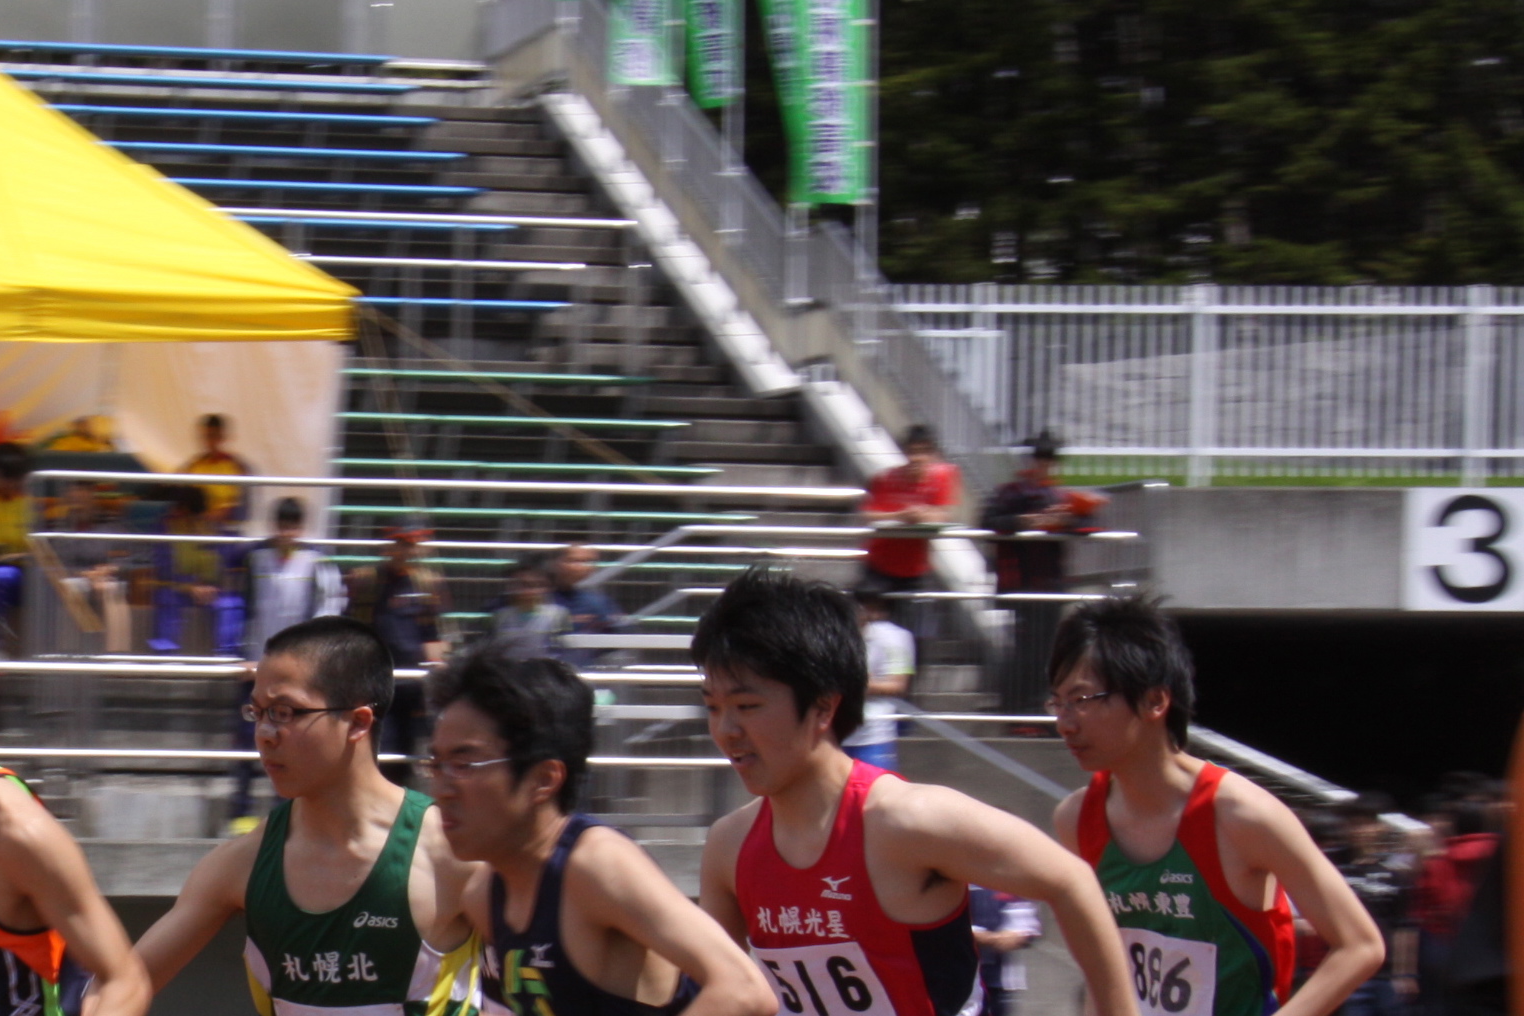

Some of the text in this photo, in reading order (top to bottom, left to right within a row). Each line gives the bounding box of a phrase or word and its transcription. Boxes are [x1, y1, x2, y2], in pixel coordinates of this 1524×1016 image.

[1428, 494, 1509, 603] 3
[757, 905, 850, 939] 札幌光星
[282, 951, 378, 983] 札幌北
